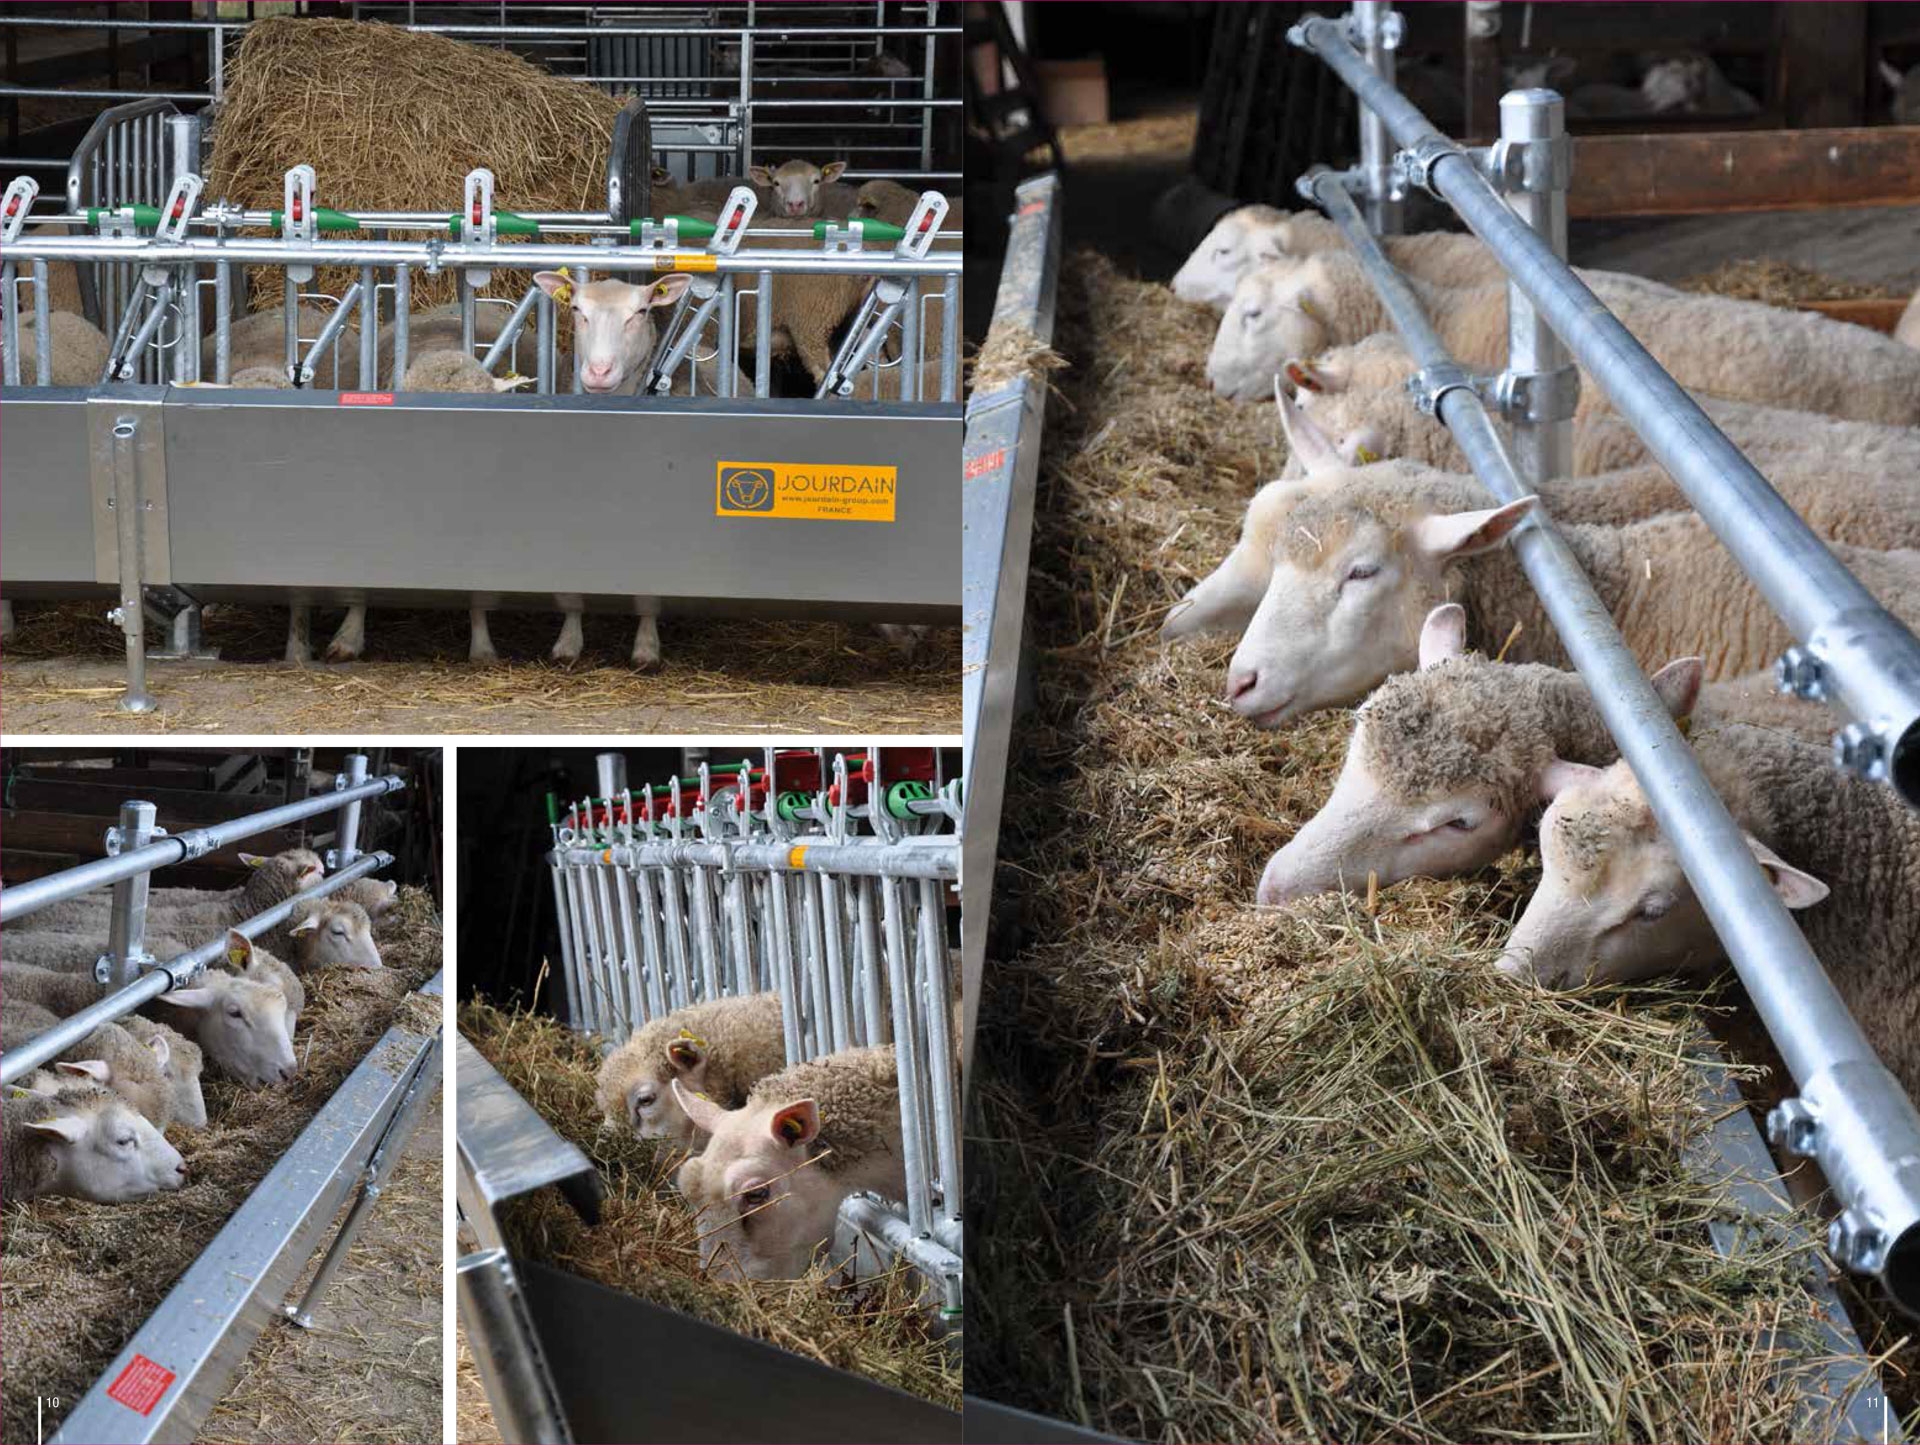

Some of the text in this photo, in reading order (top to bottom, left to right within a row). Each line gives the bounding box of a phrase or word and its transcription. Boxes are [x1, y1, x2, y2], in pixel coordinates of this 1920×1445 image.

[778, 474, 894, 494] JOURDAIN
[781, 495, 889, 505] www.jourdain-group.com
[817, 506, 853, 515] FRANCE
